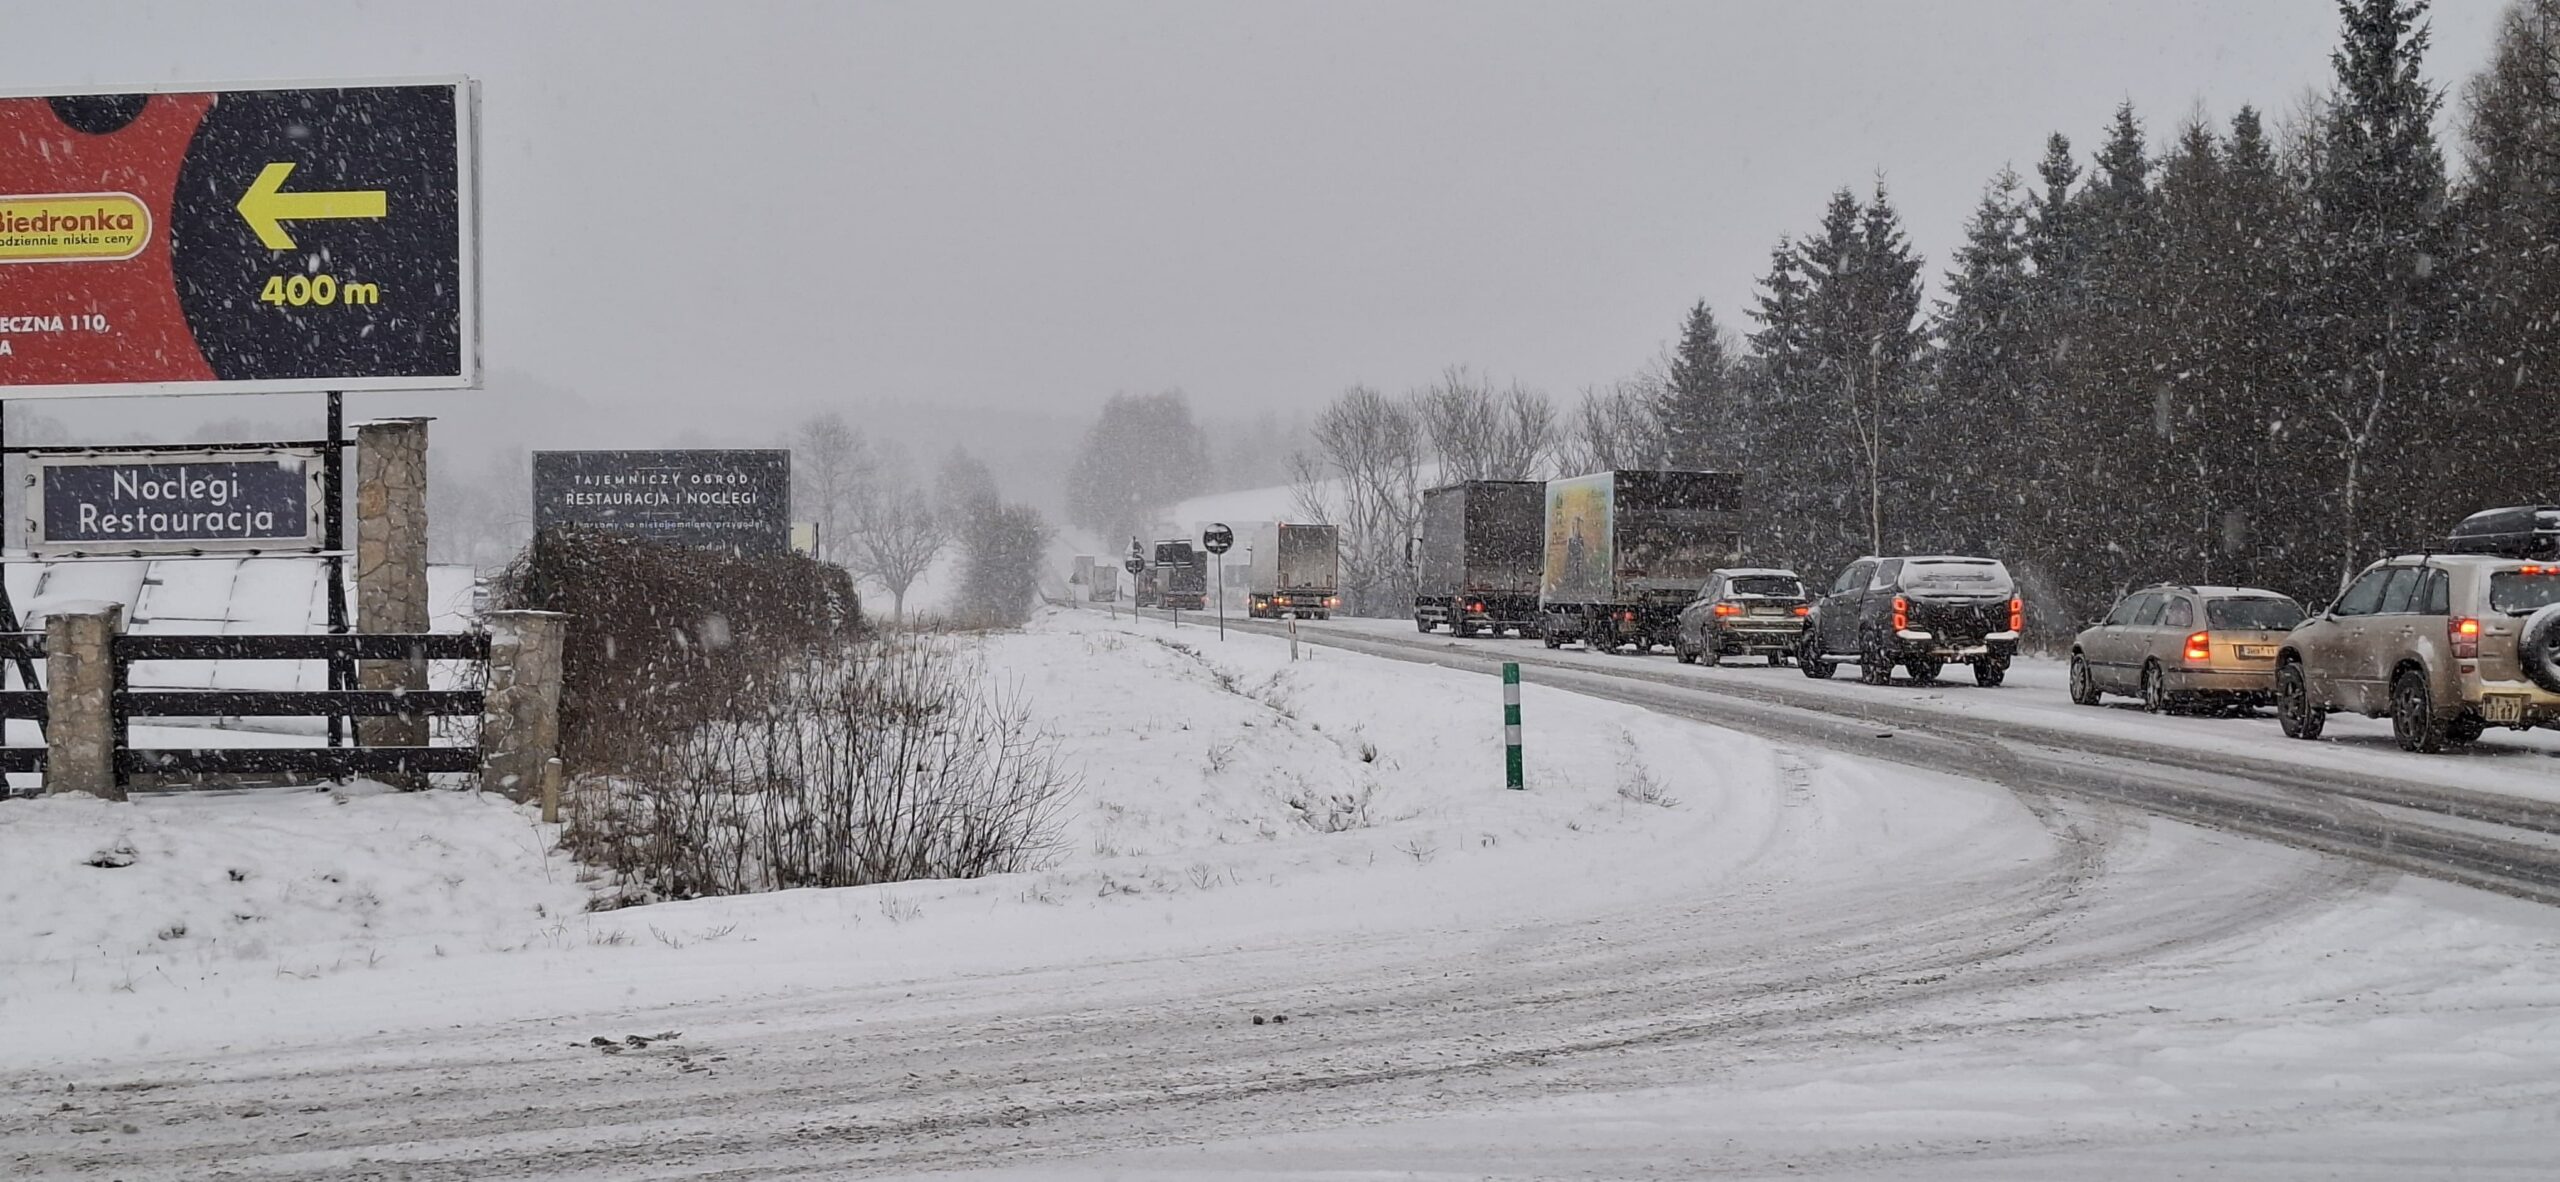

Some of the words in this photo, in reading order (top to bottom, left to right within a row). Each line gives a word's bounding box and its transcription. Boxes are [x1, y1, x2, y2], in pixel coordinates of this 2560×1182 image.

[63, 233, 100, 245] niskie
[104, 235, 134, 246] ceny
[261, 274, 337, 306] 400
[344, 283, 379, 305] m
[0, 315, 64, 333] ECZNA
[70, 314, 111, 333] 110,
[113, 467, 239, 505] Noclegi
[574, 473, 681, 487] TAJEMNICZY
[566, 493, 670, 507] RESTAURACJA
[675, 492, 681, 505] I
[687, 492, 757, 505] NOCLEGI
[79, 503, 274, 537] Restauracja
